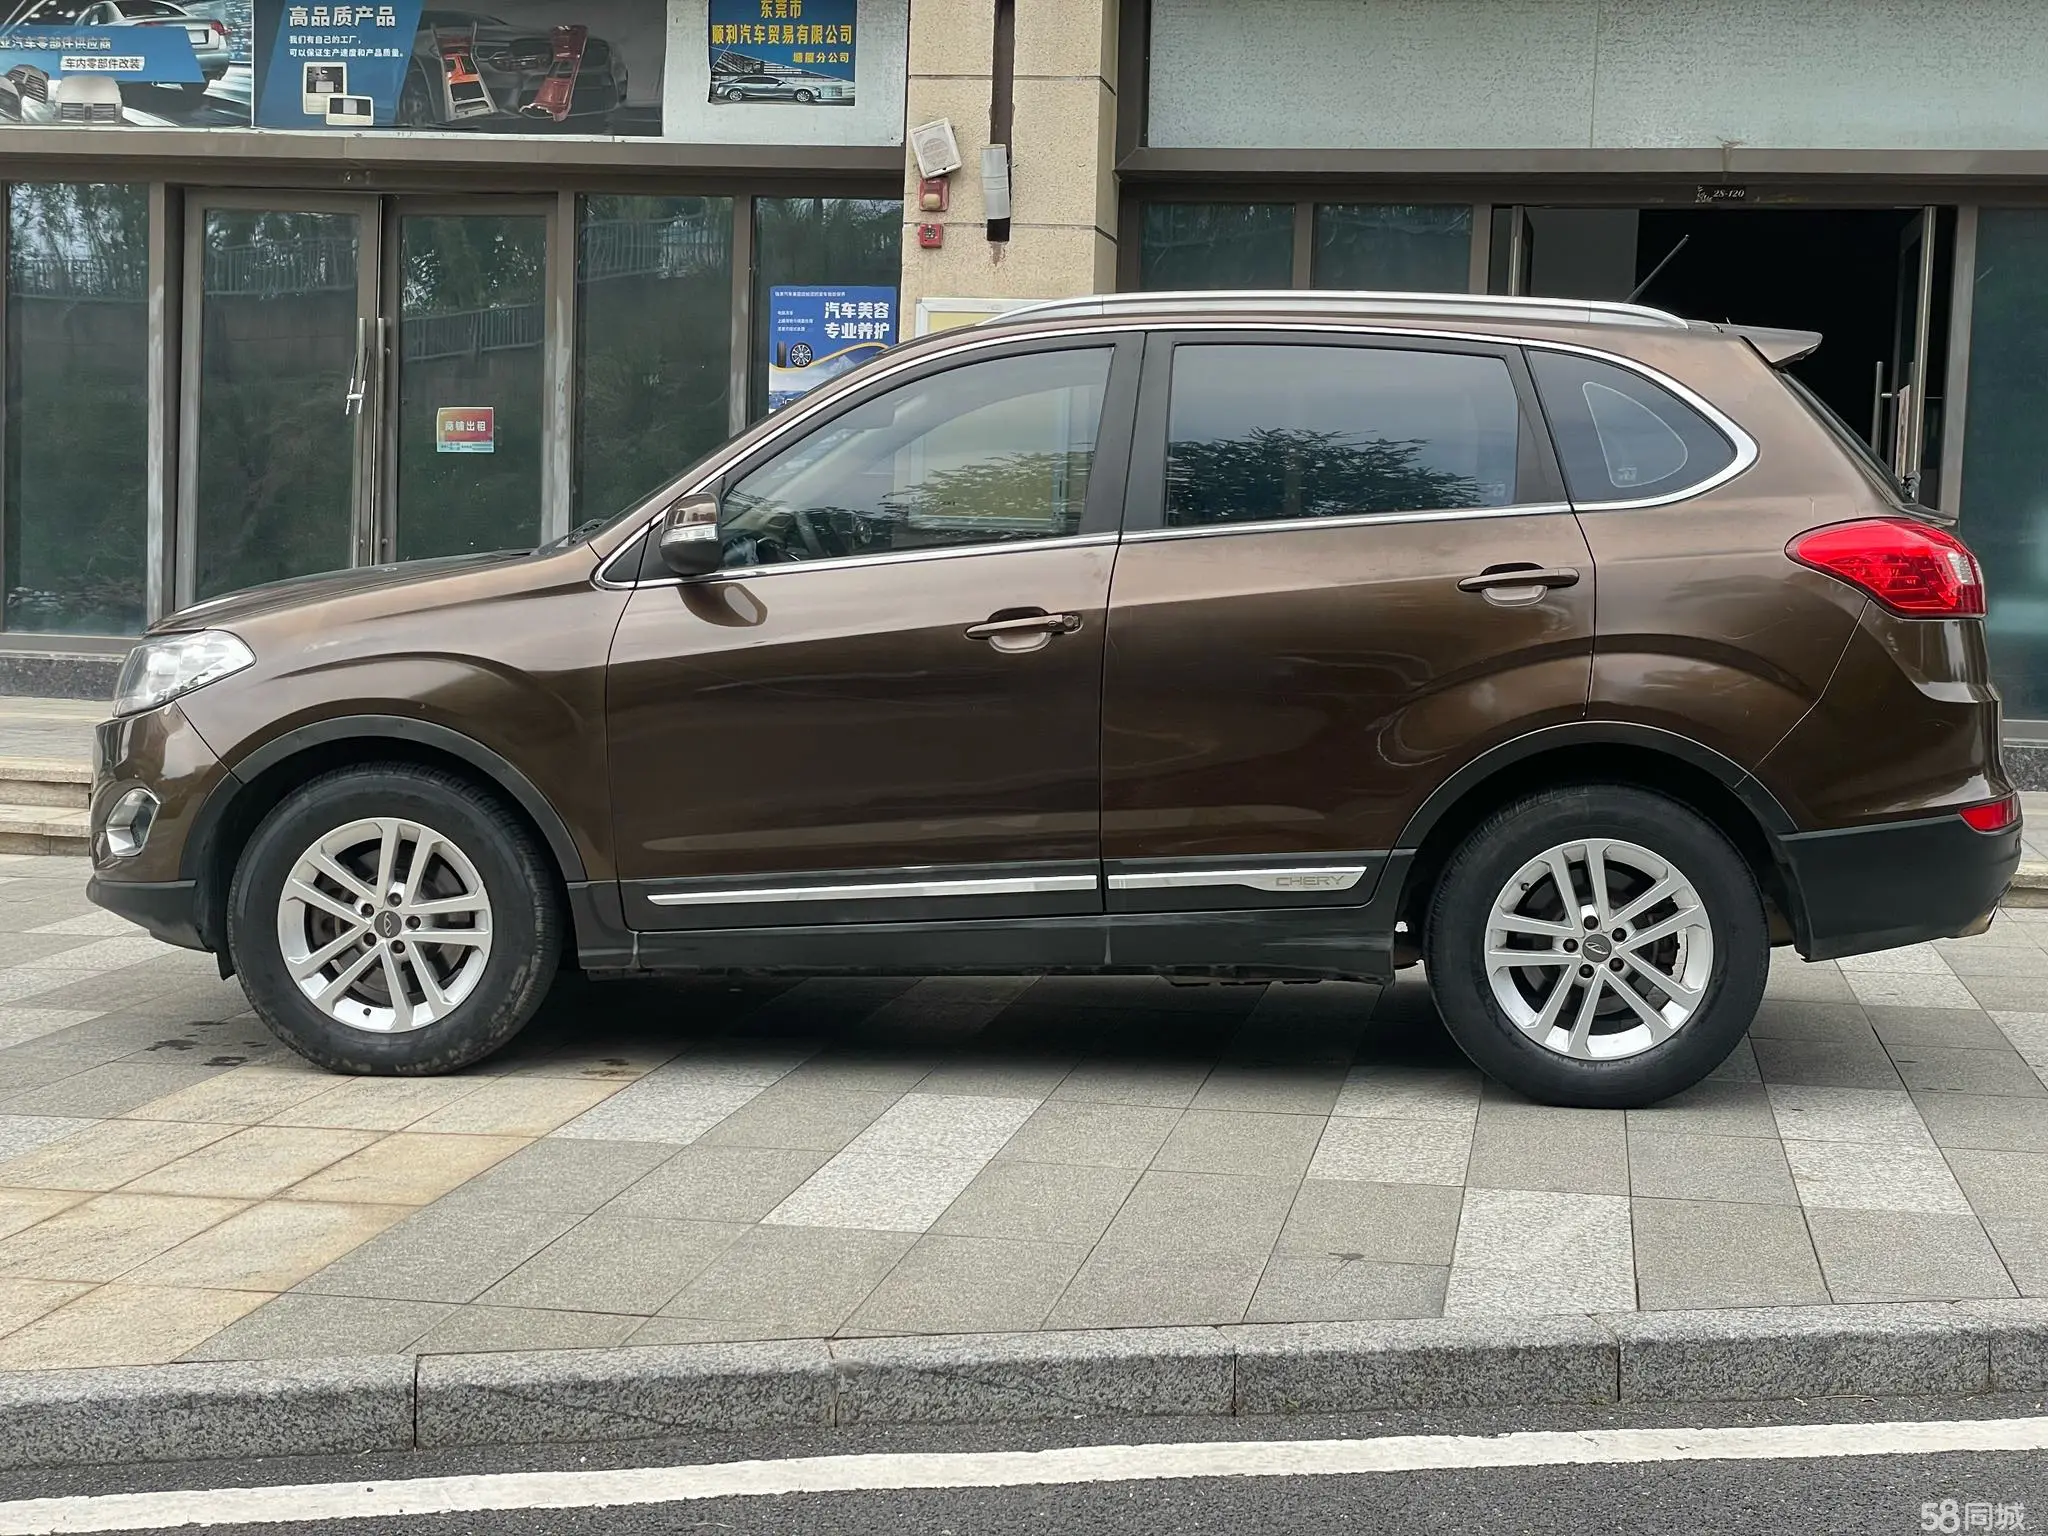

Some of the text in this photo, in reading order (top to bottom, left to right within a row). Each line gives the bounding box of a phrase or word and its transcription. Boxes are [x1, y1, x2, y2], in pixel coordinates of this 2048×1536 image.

[289, 6, 396, 27] 高品质产品
[760, 0, 803, 19] 东莞市
[289, 35, 361, 45] 我们有自己的工厂，
[711, 24, 852, 44] 顺利汽车贸易有限公司
[289, 48, 404, 58] 可以保证生产速度和产品质量。
[65, 58, 140, 69] 车内零部件改装
[824, 301, 890, 319] 汽车美容
[824, 322, 890, 340] 专业养护
[1276, 875, 1344, 887] CHERY
